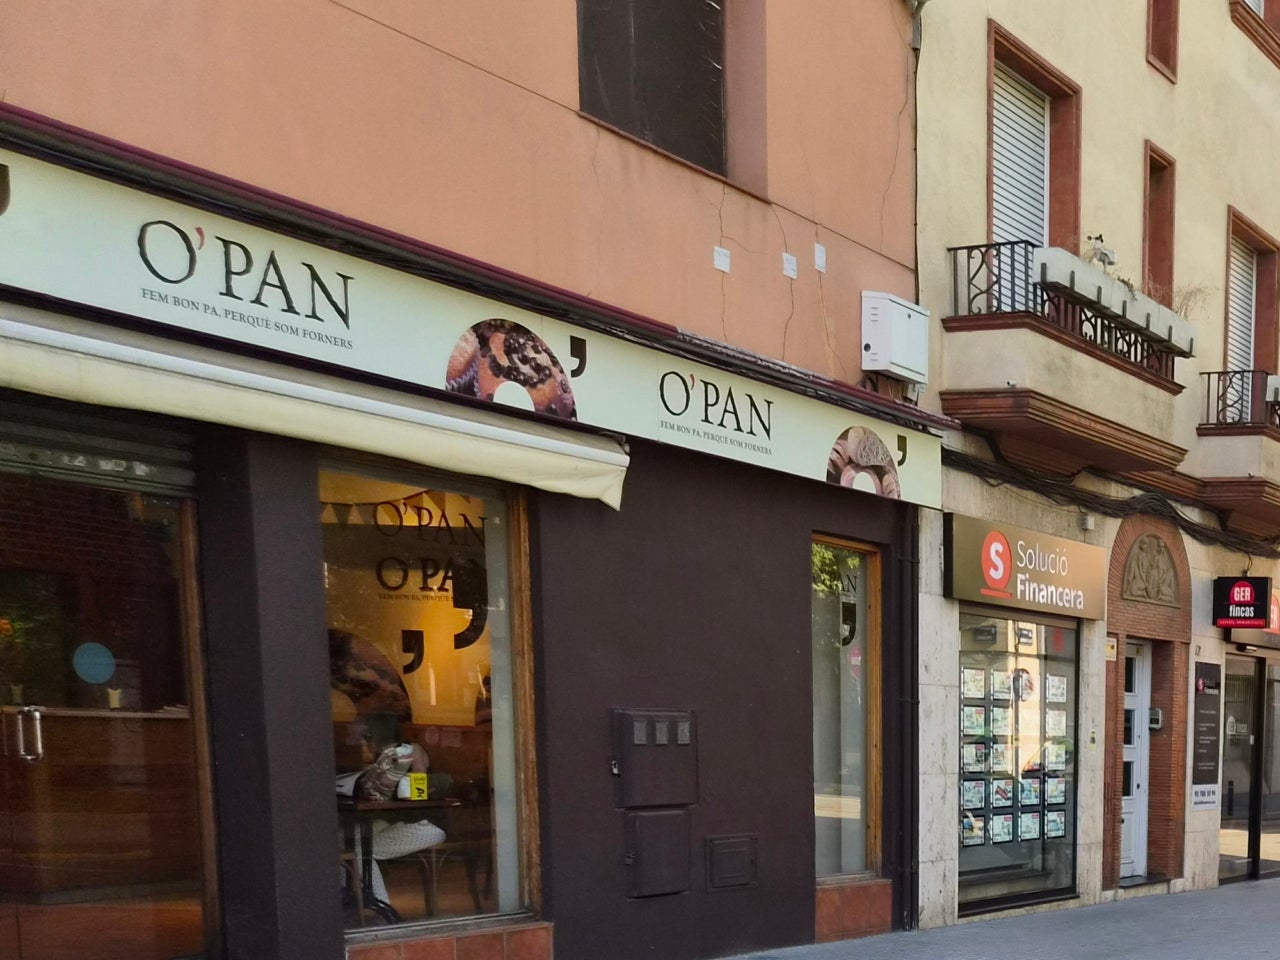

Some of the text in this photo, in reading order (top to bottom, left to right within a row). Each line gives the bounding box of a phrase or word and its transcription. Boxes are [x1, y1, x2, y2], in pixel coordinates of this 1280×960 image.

[137, 219, 355, 330] O'PAN
[141, 287, 353, 350] FEM BON PA, PERQUÈ SOM FORNERS
[659, 370, 774, 441] O'PAN
[660, 420, 675, 431] FEM
[676, 424, 691, 436] BON
[730, 437, 743, 449] SOM
[744, 441, 773, 456] FORNERS
[373, 500, 488, 548] O'PAN
[1016, 540, 1068, 576] Solució
[1016, 573, 1084, 610] Financera
[1234, 587, 1251, 602] GER
[1229, 604, 1254, 618] fincas
